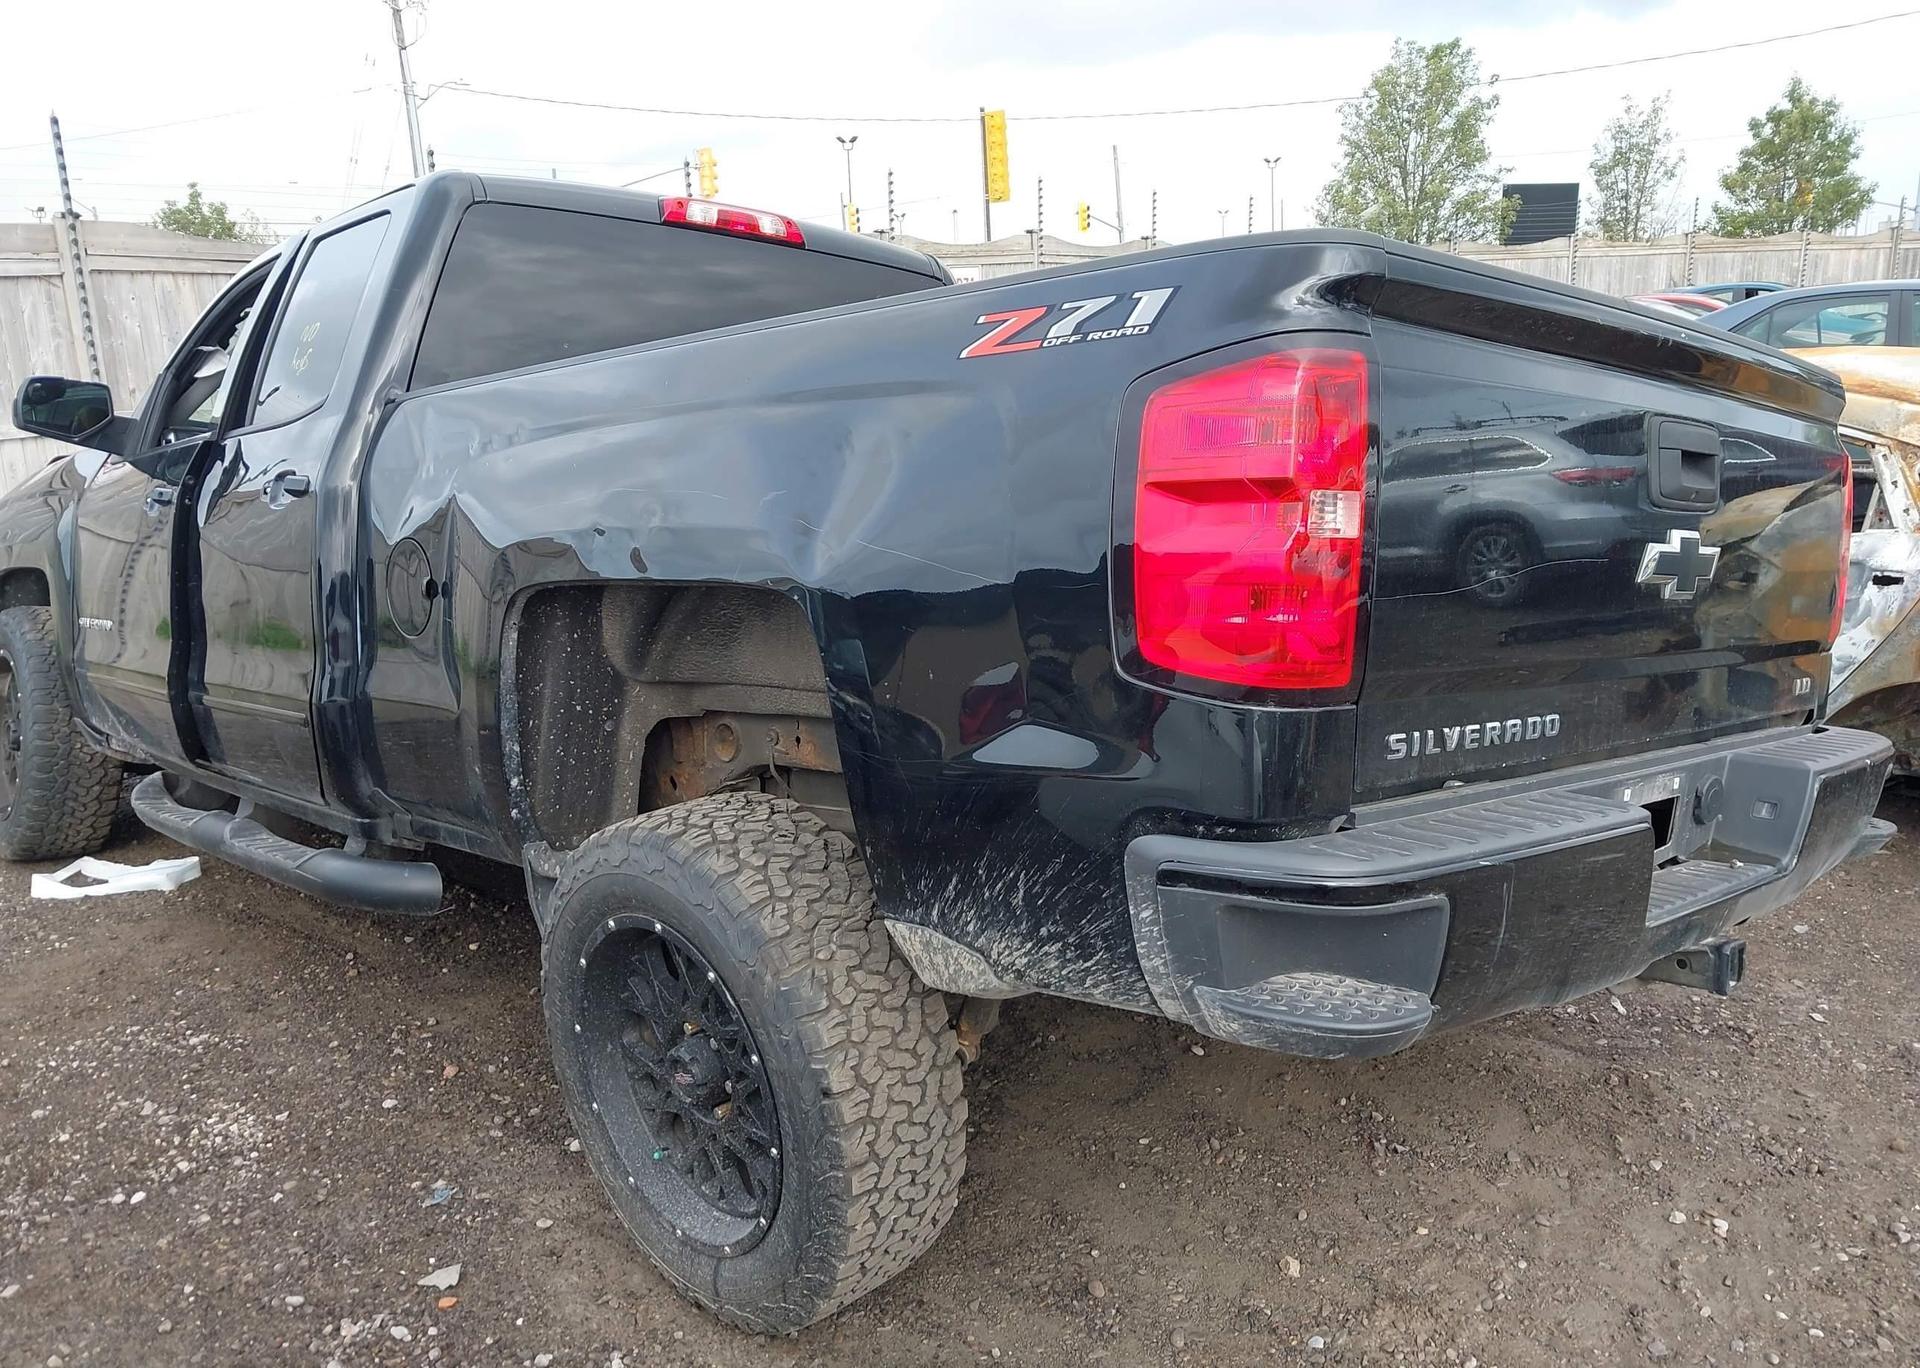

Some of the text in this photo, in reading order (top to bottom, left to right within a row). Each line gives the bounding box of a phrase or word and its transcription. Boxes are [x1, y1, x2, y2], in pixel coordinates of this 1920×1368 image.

[958, 286, 1180, 360] Z71
[1043, 325, 1151, 348] OFF ROAD
[1385, 713, 1561, 760] SILVERADO
